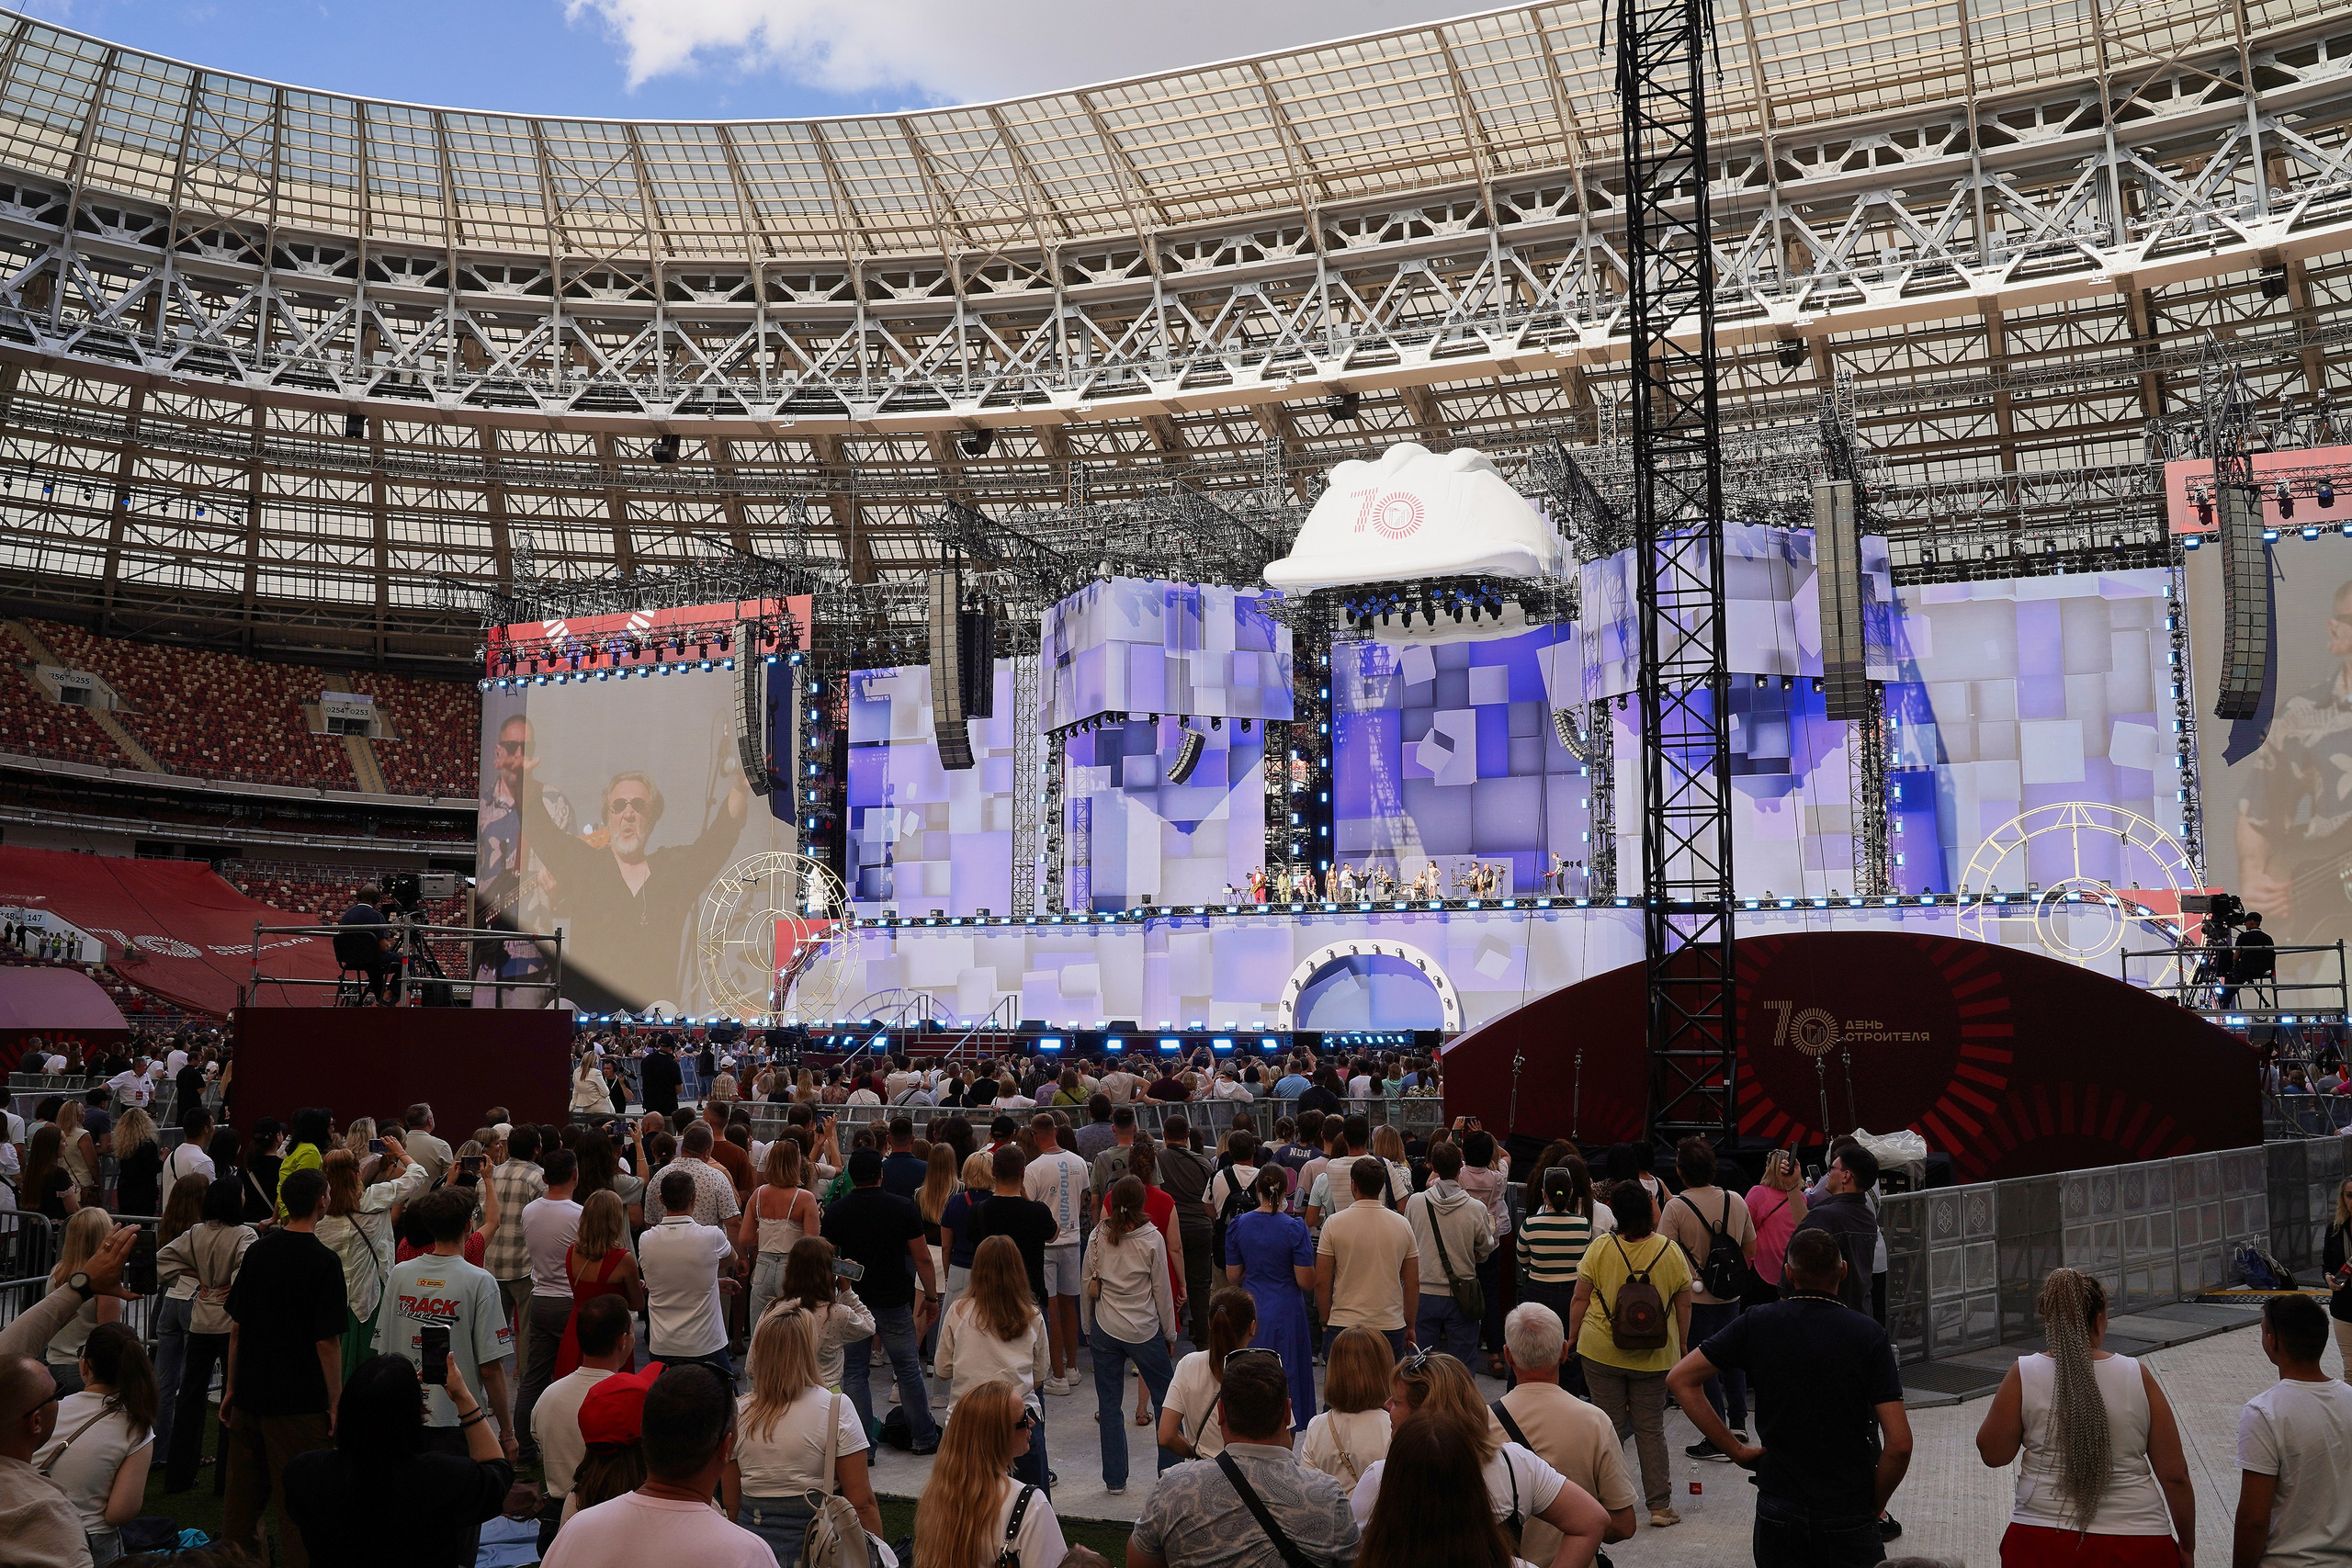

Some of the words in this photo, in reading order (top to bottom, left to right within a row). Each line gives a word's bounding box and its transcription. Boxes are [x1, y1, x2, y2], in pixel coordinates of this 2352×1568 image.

[27, 913, 42, 922] 147
[1845, 1021, 1883, 1030] ДЕНЬ
[1845, 1032, 1930, 1042] СТРОИТЕЛЯ
[1057, 1161, 1070, 1230] AQUAPOLIS
[399, 1295, 460, 1316] TRACK
